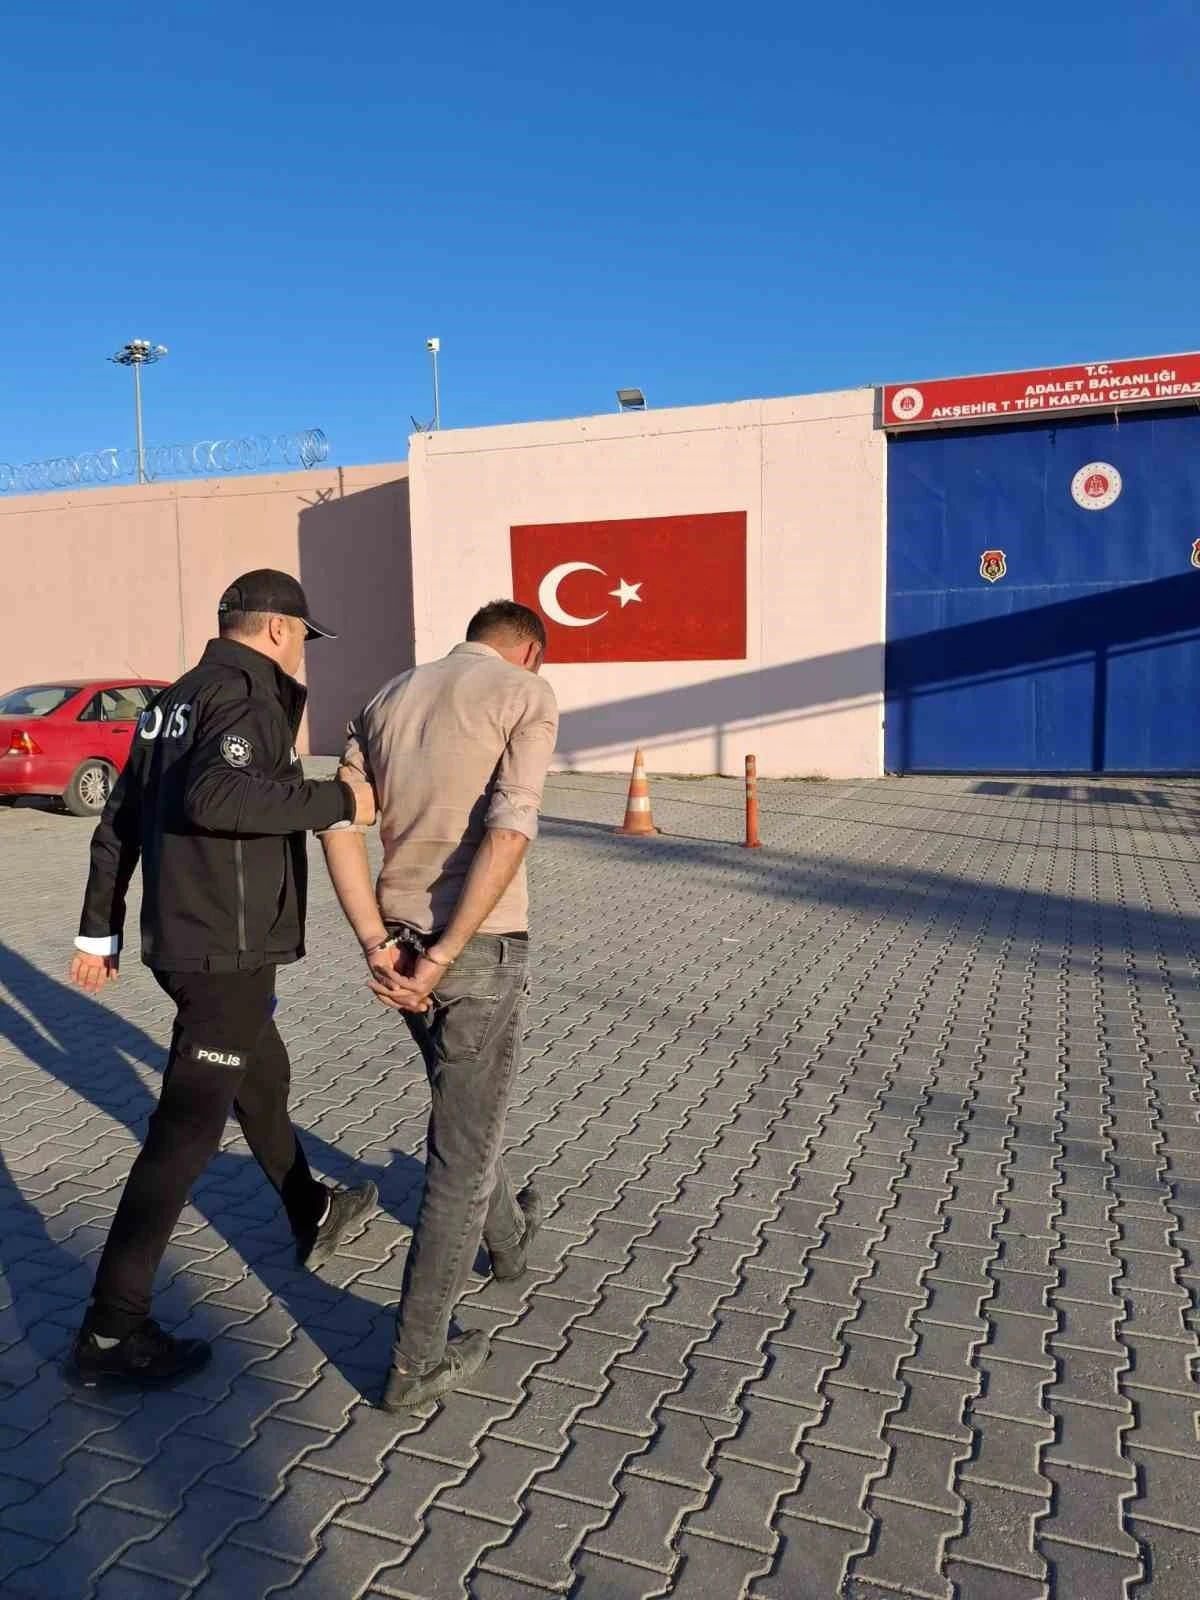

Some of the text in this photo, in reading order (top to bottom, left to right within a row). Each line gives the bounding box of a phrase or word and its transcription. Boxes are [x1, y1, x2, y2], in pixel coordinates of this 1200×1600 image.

[1024, 369, 1176, 395] ADALET BAKANLIĞI
[1085, 364, 1113, 376] T.C.
[931, 382, 1200, 417] AKŞEHİR T TİPİ KAPALI CEZA İNFAZ
